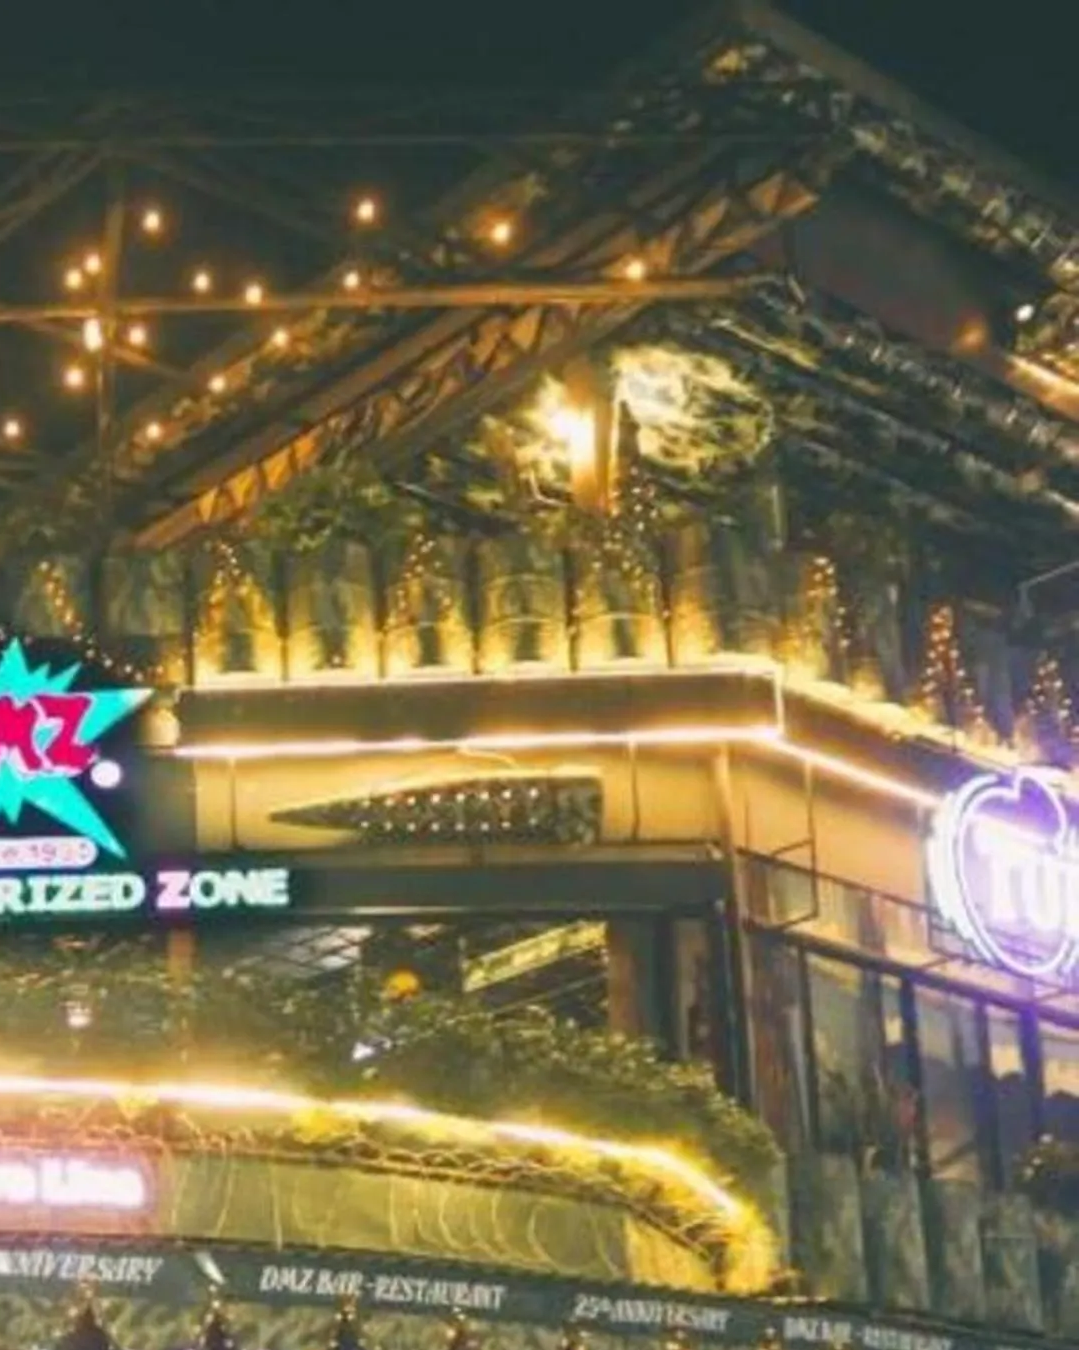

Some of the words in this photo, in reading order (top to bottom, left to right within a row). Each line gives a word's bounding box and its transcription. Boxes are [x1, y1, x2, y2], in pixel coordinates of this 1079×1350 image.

[156, 868, 290, 910] ZONE
[259, 1264, 311, 1292] DMZ
[374, 1273, 507, 1310] RESTAURANT
